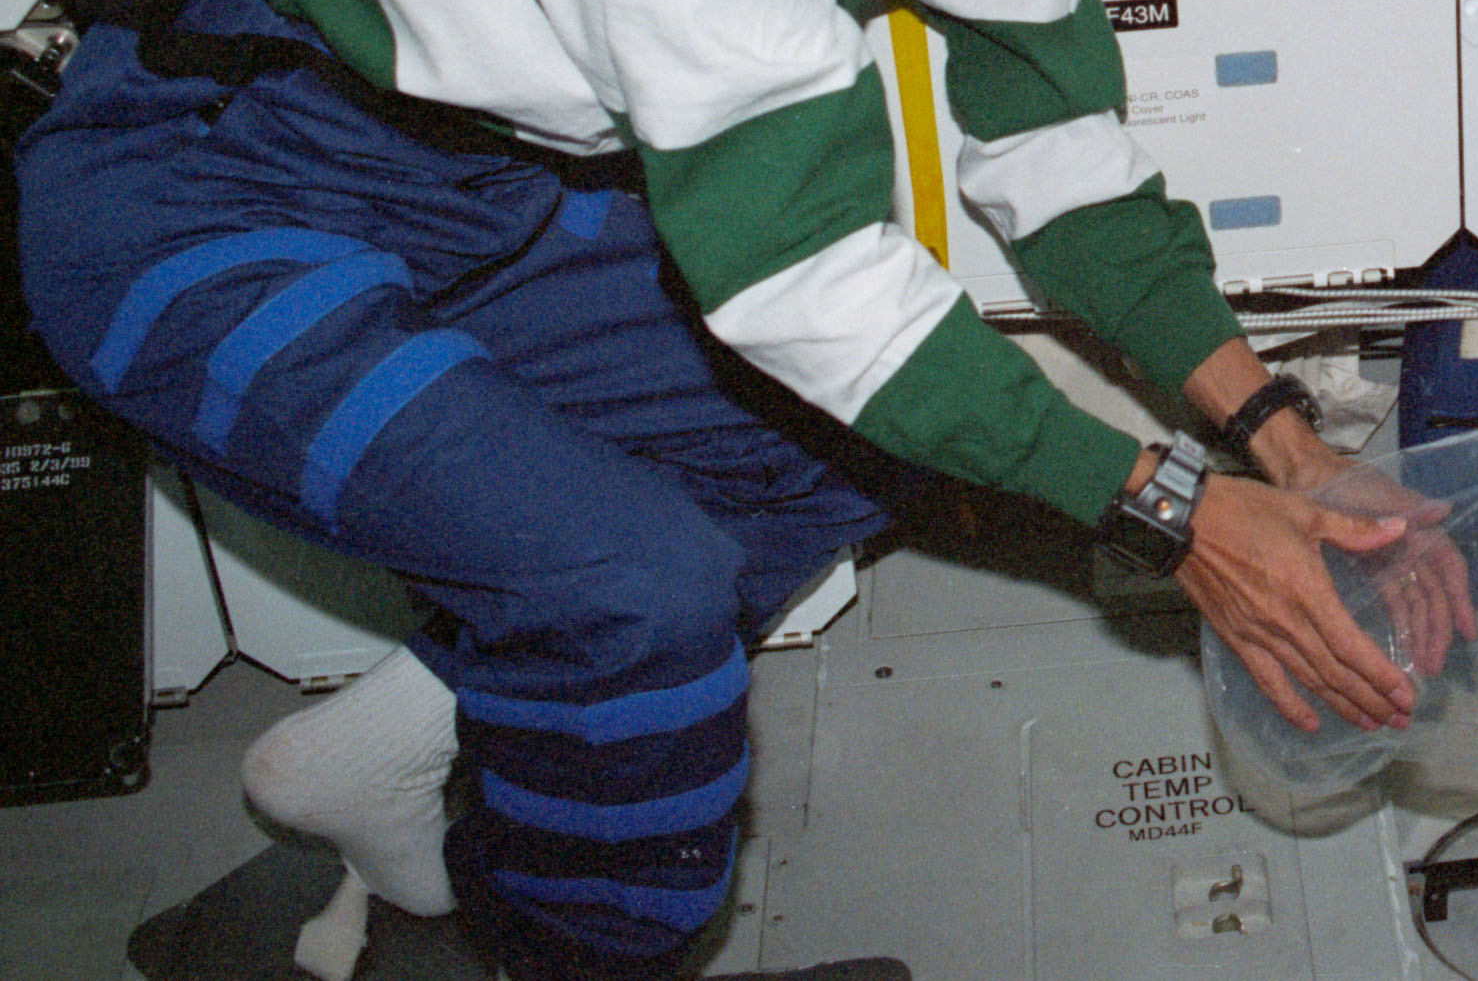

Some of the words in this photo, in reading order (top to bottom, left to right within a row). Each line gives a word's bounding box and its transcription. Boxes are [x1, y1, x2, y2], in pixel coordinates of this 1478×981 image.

[1105, 4, 1170, 24] F43M
[1179, 112, 1206, 126] Light
[1112, 752, 1212, 779] CABIN
[1122, 776, 1213, 802] TEMP
[1095, 793, 1256, 829] CONTROL
[1129, 822, 1203, 842] MD44F
